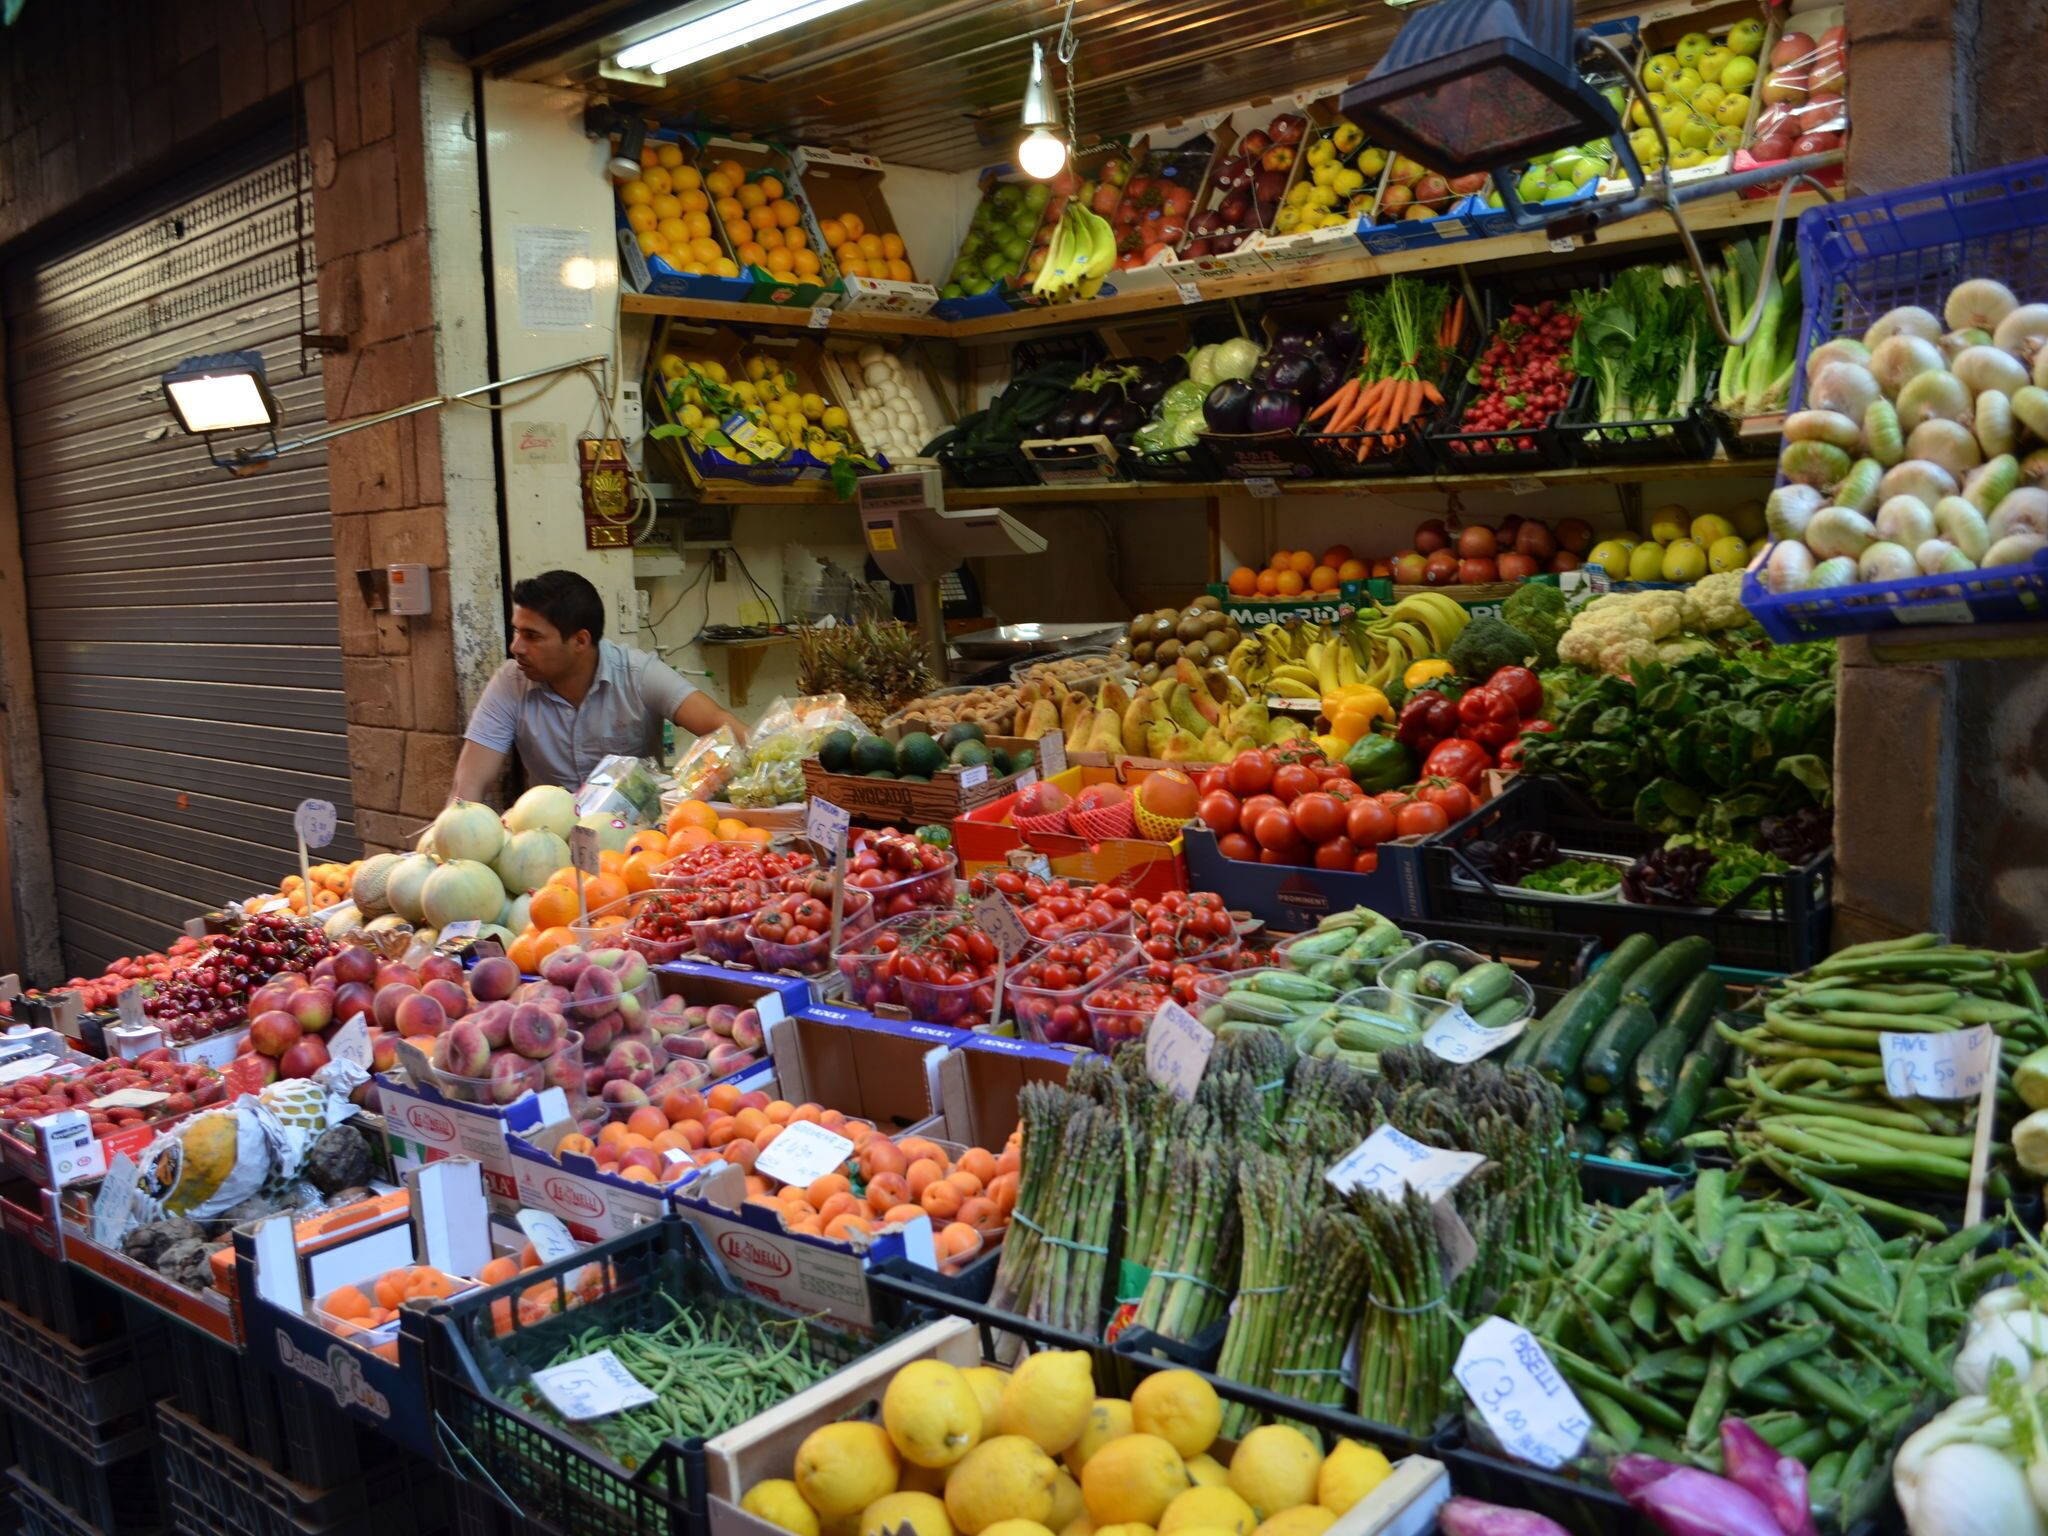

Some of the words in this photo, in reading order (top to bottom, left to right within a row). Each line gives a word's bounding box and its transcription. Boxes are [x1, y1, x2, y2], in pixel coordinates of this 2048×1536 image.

[1230, 606, 1341, 626] MelaPiù
[852, 787, 913, 805] AVOCADO
[1277, 894, 1327, 906] PROMINENT
[807, 1007, 848, 1021] VIGNOLA
[910, 1025, 956, 1039] VIGNOLA
[977, 1037, 1023, 1051] VIGNOLA
[1891, 1035, 1929, 1052] FAVE
[727, 1237, 784, 1273] LEONELLI
[279, 1331, 338, 1388] DEMETRA
[1510, 1332, 1562, 1398] PISELLI
